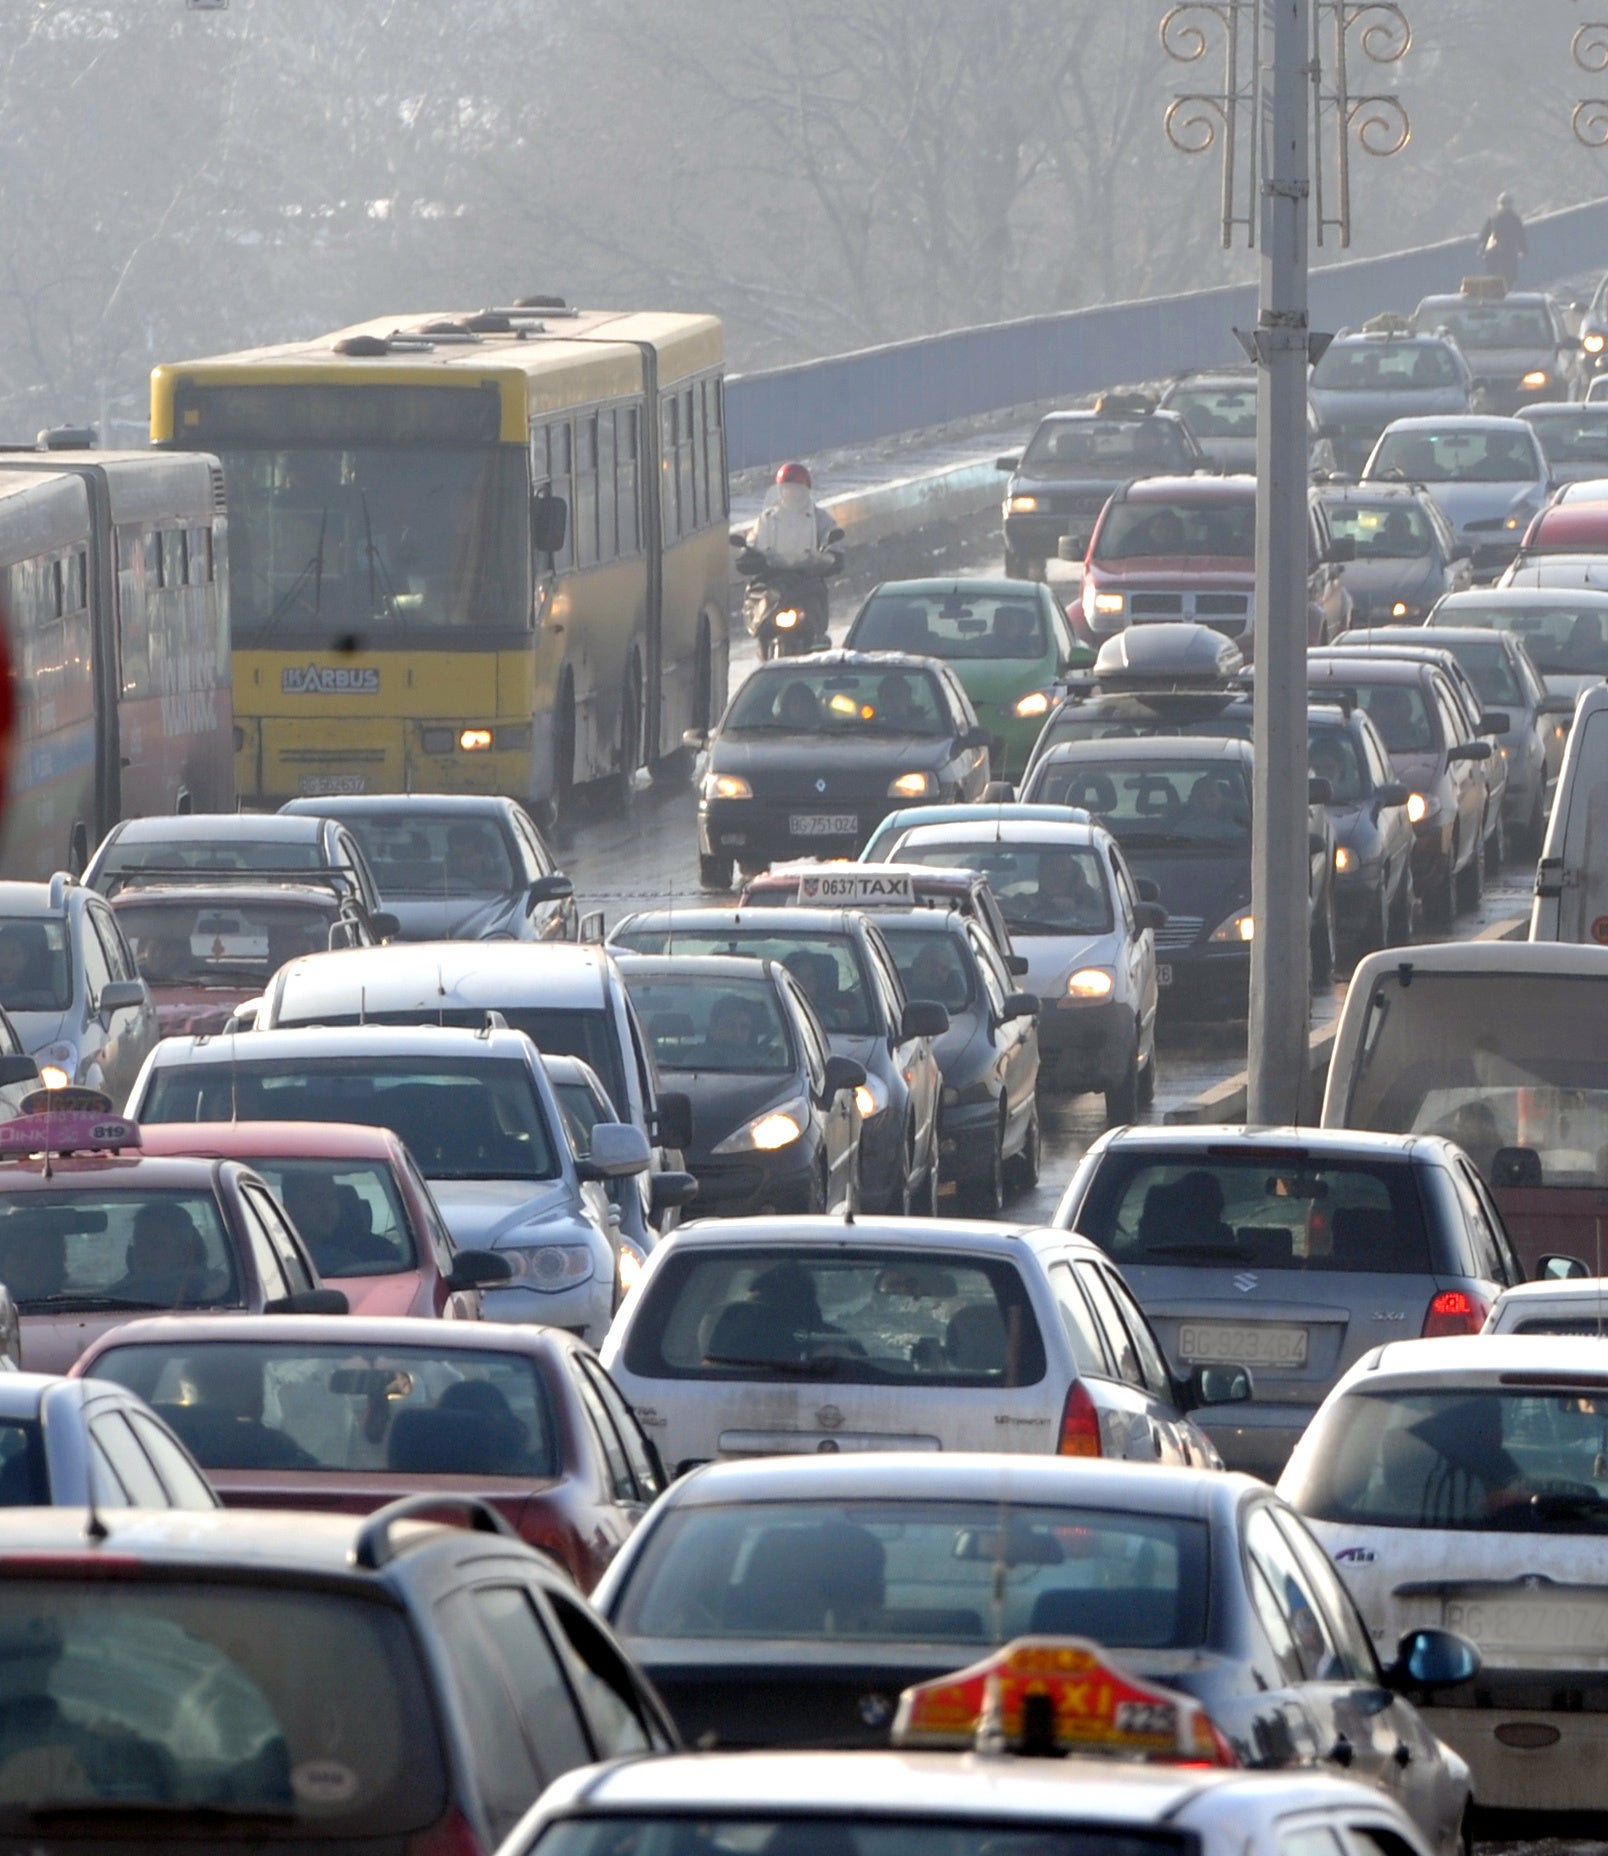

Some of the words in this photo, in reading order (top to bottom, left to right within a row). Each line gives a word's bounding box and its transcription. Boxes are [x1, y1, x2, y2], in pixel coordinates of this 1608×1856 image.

[283, 663, 378, 689] IKARBUS
[822, 880, 854, 895] 0637
[858, 879, 908, 895] TAXI
[93, 1126, 124, 1138] 819
